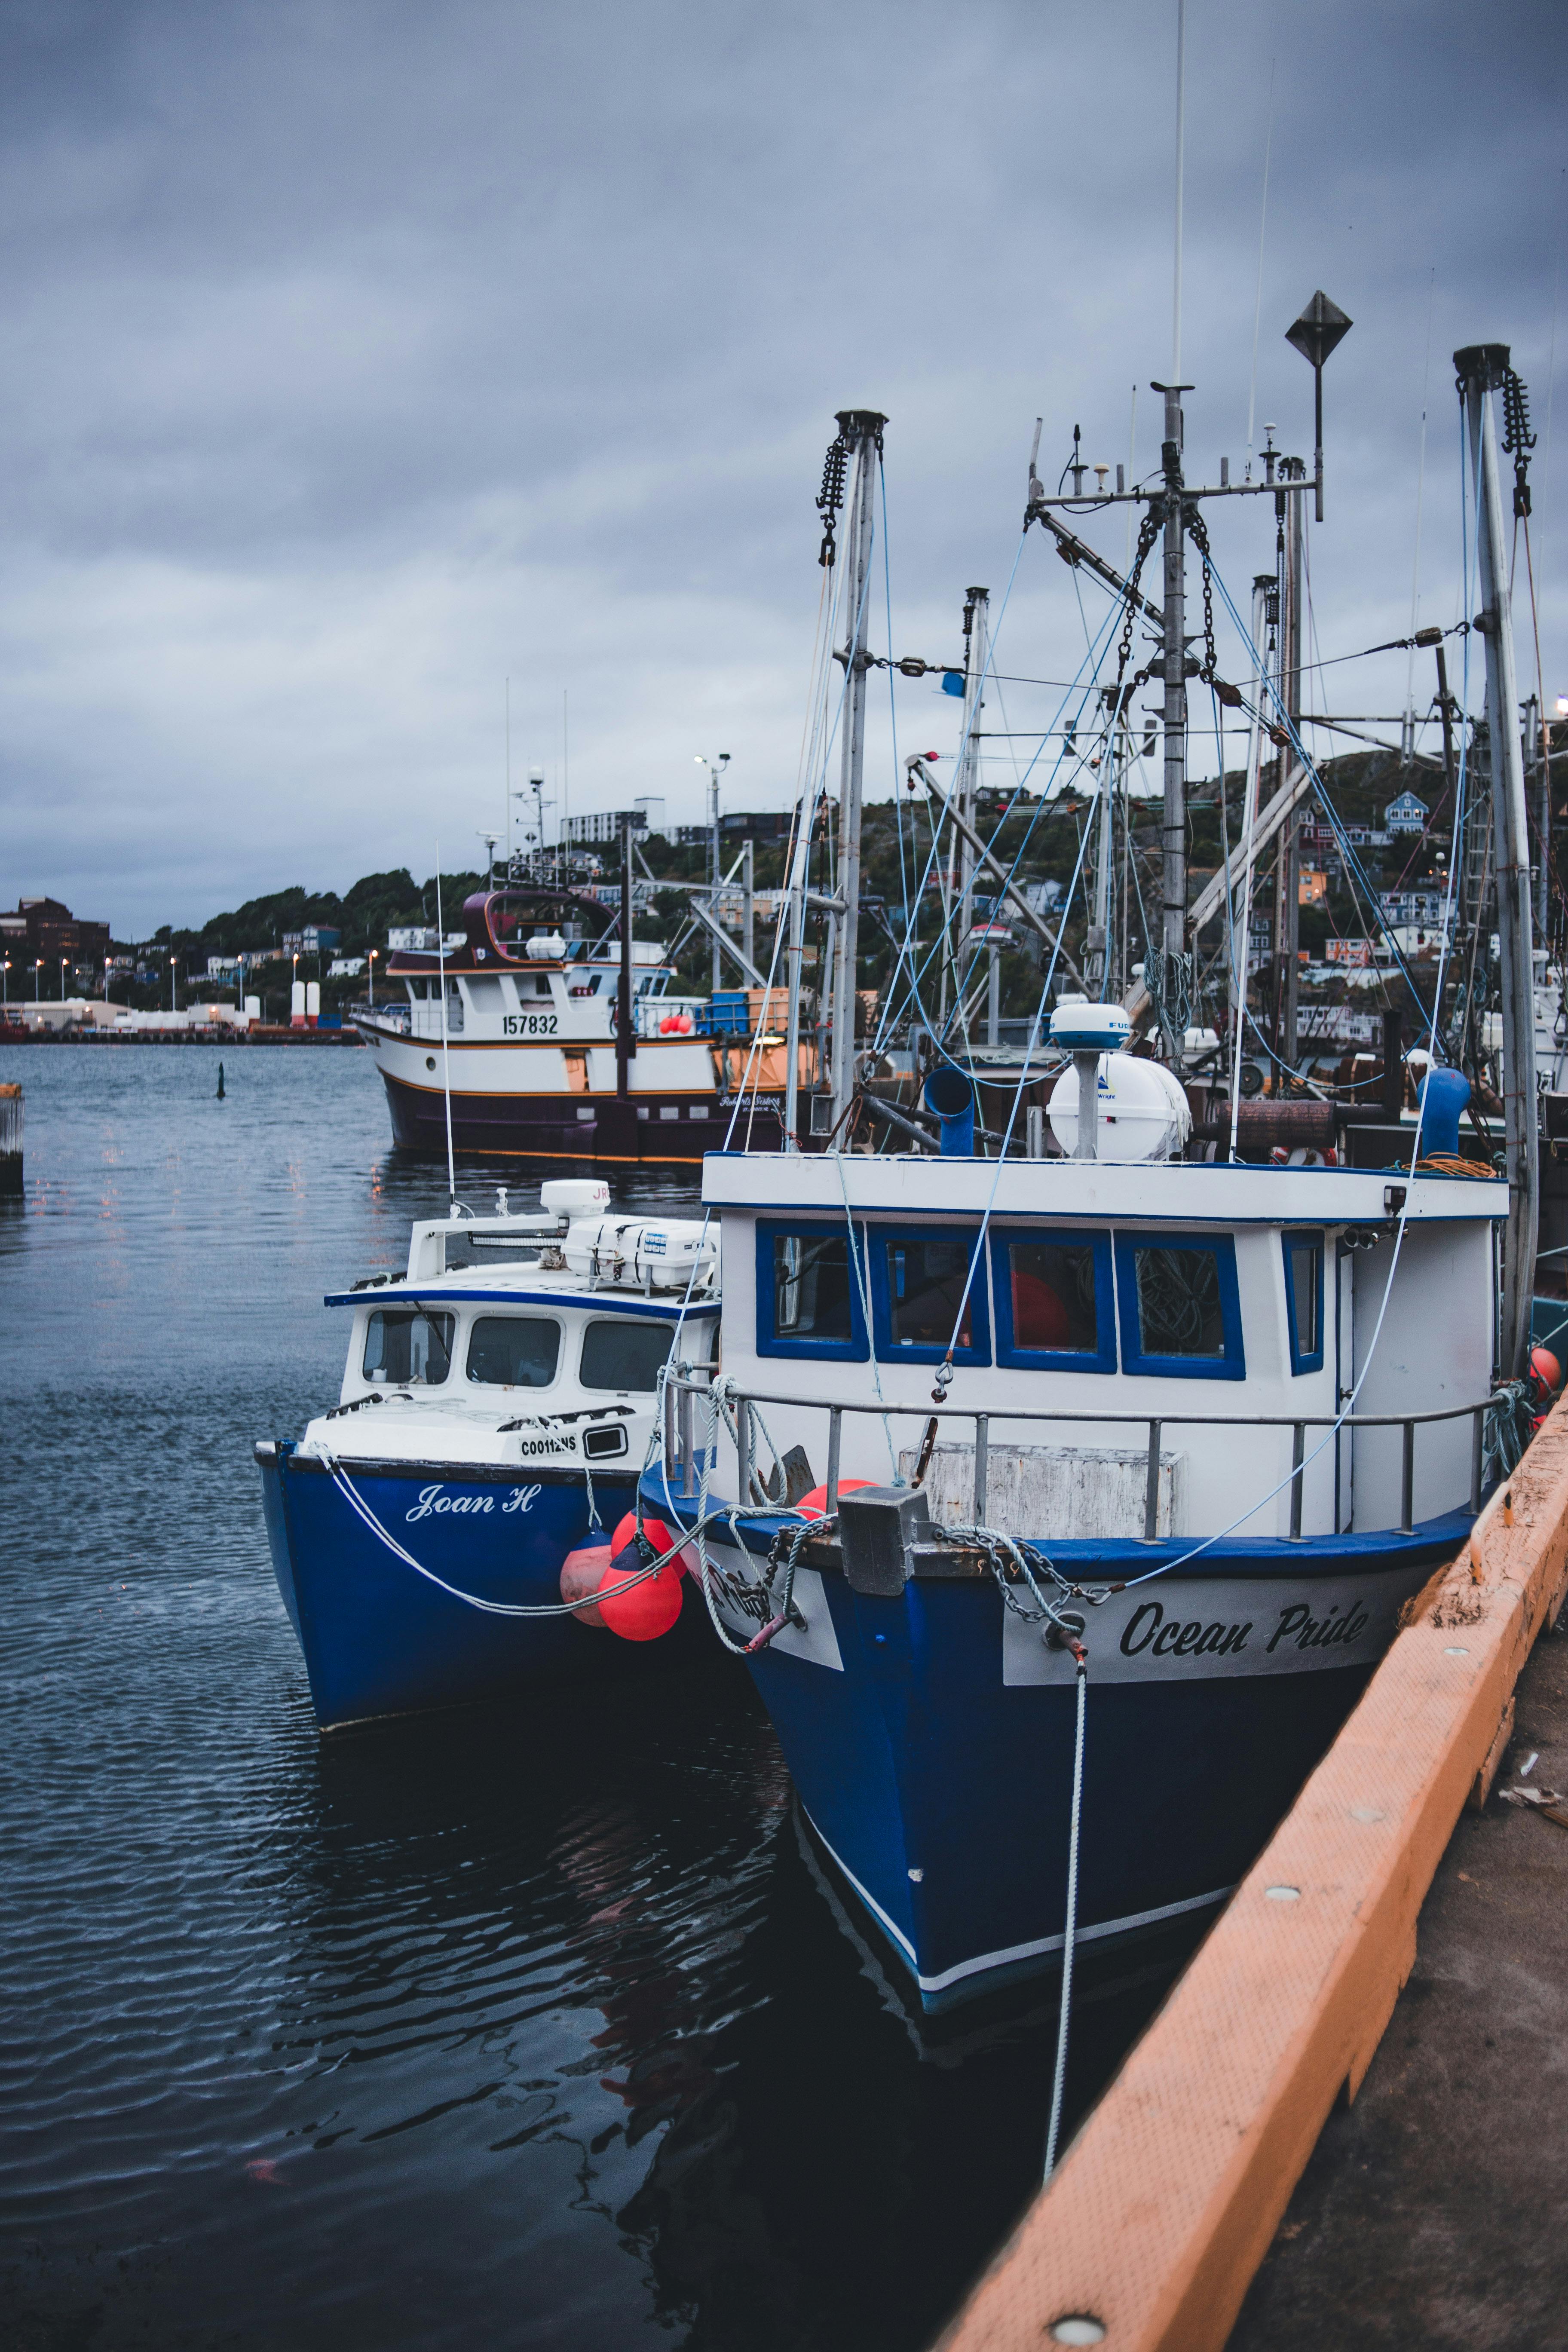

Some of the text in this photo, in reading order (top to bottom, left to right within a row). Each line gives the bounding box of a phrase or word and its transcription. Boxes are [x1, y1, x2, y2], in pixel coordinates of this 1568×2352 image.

[503, 1015, 557, 1034] 157832
[720, 1096, 751, 1106] Robrts
[406, 1484, 542, 1522] Joan H
[1120, 1599, 1369, 1657] Ocean Pride
